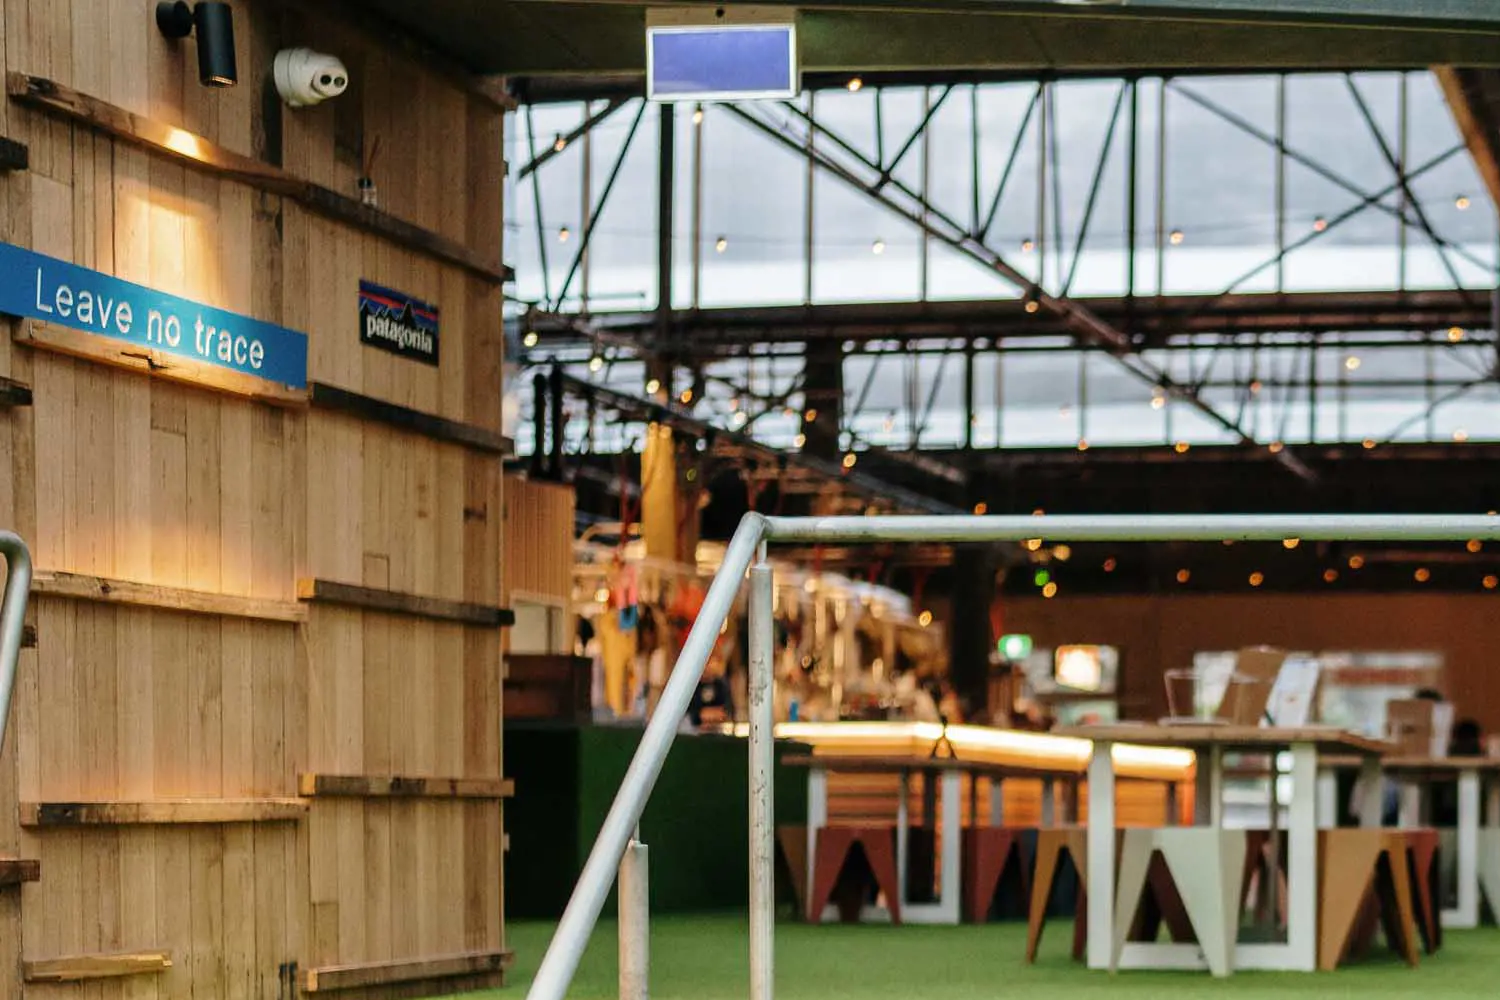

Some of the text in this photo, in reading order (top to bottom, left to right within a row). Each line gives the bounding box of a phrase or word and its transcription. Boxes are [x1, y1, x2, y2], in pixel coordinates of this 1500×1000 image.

[35, 266, 264, 369] Leave no trace
[366, 314, 433, 354] patagonia
